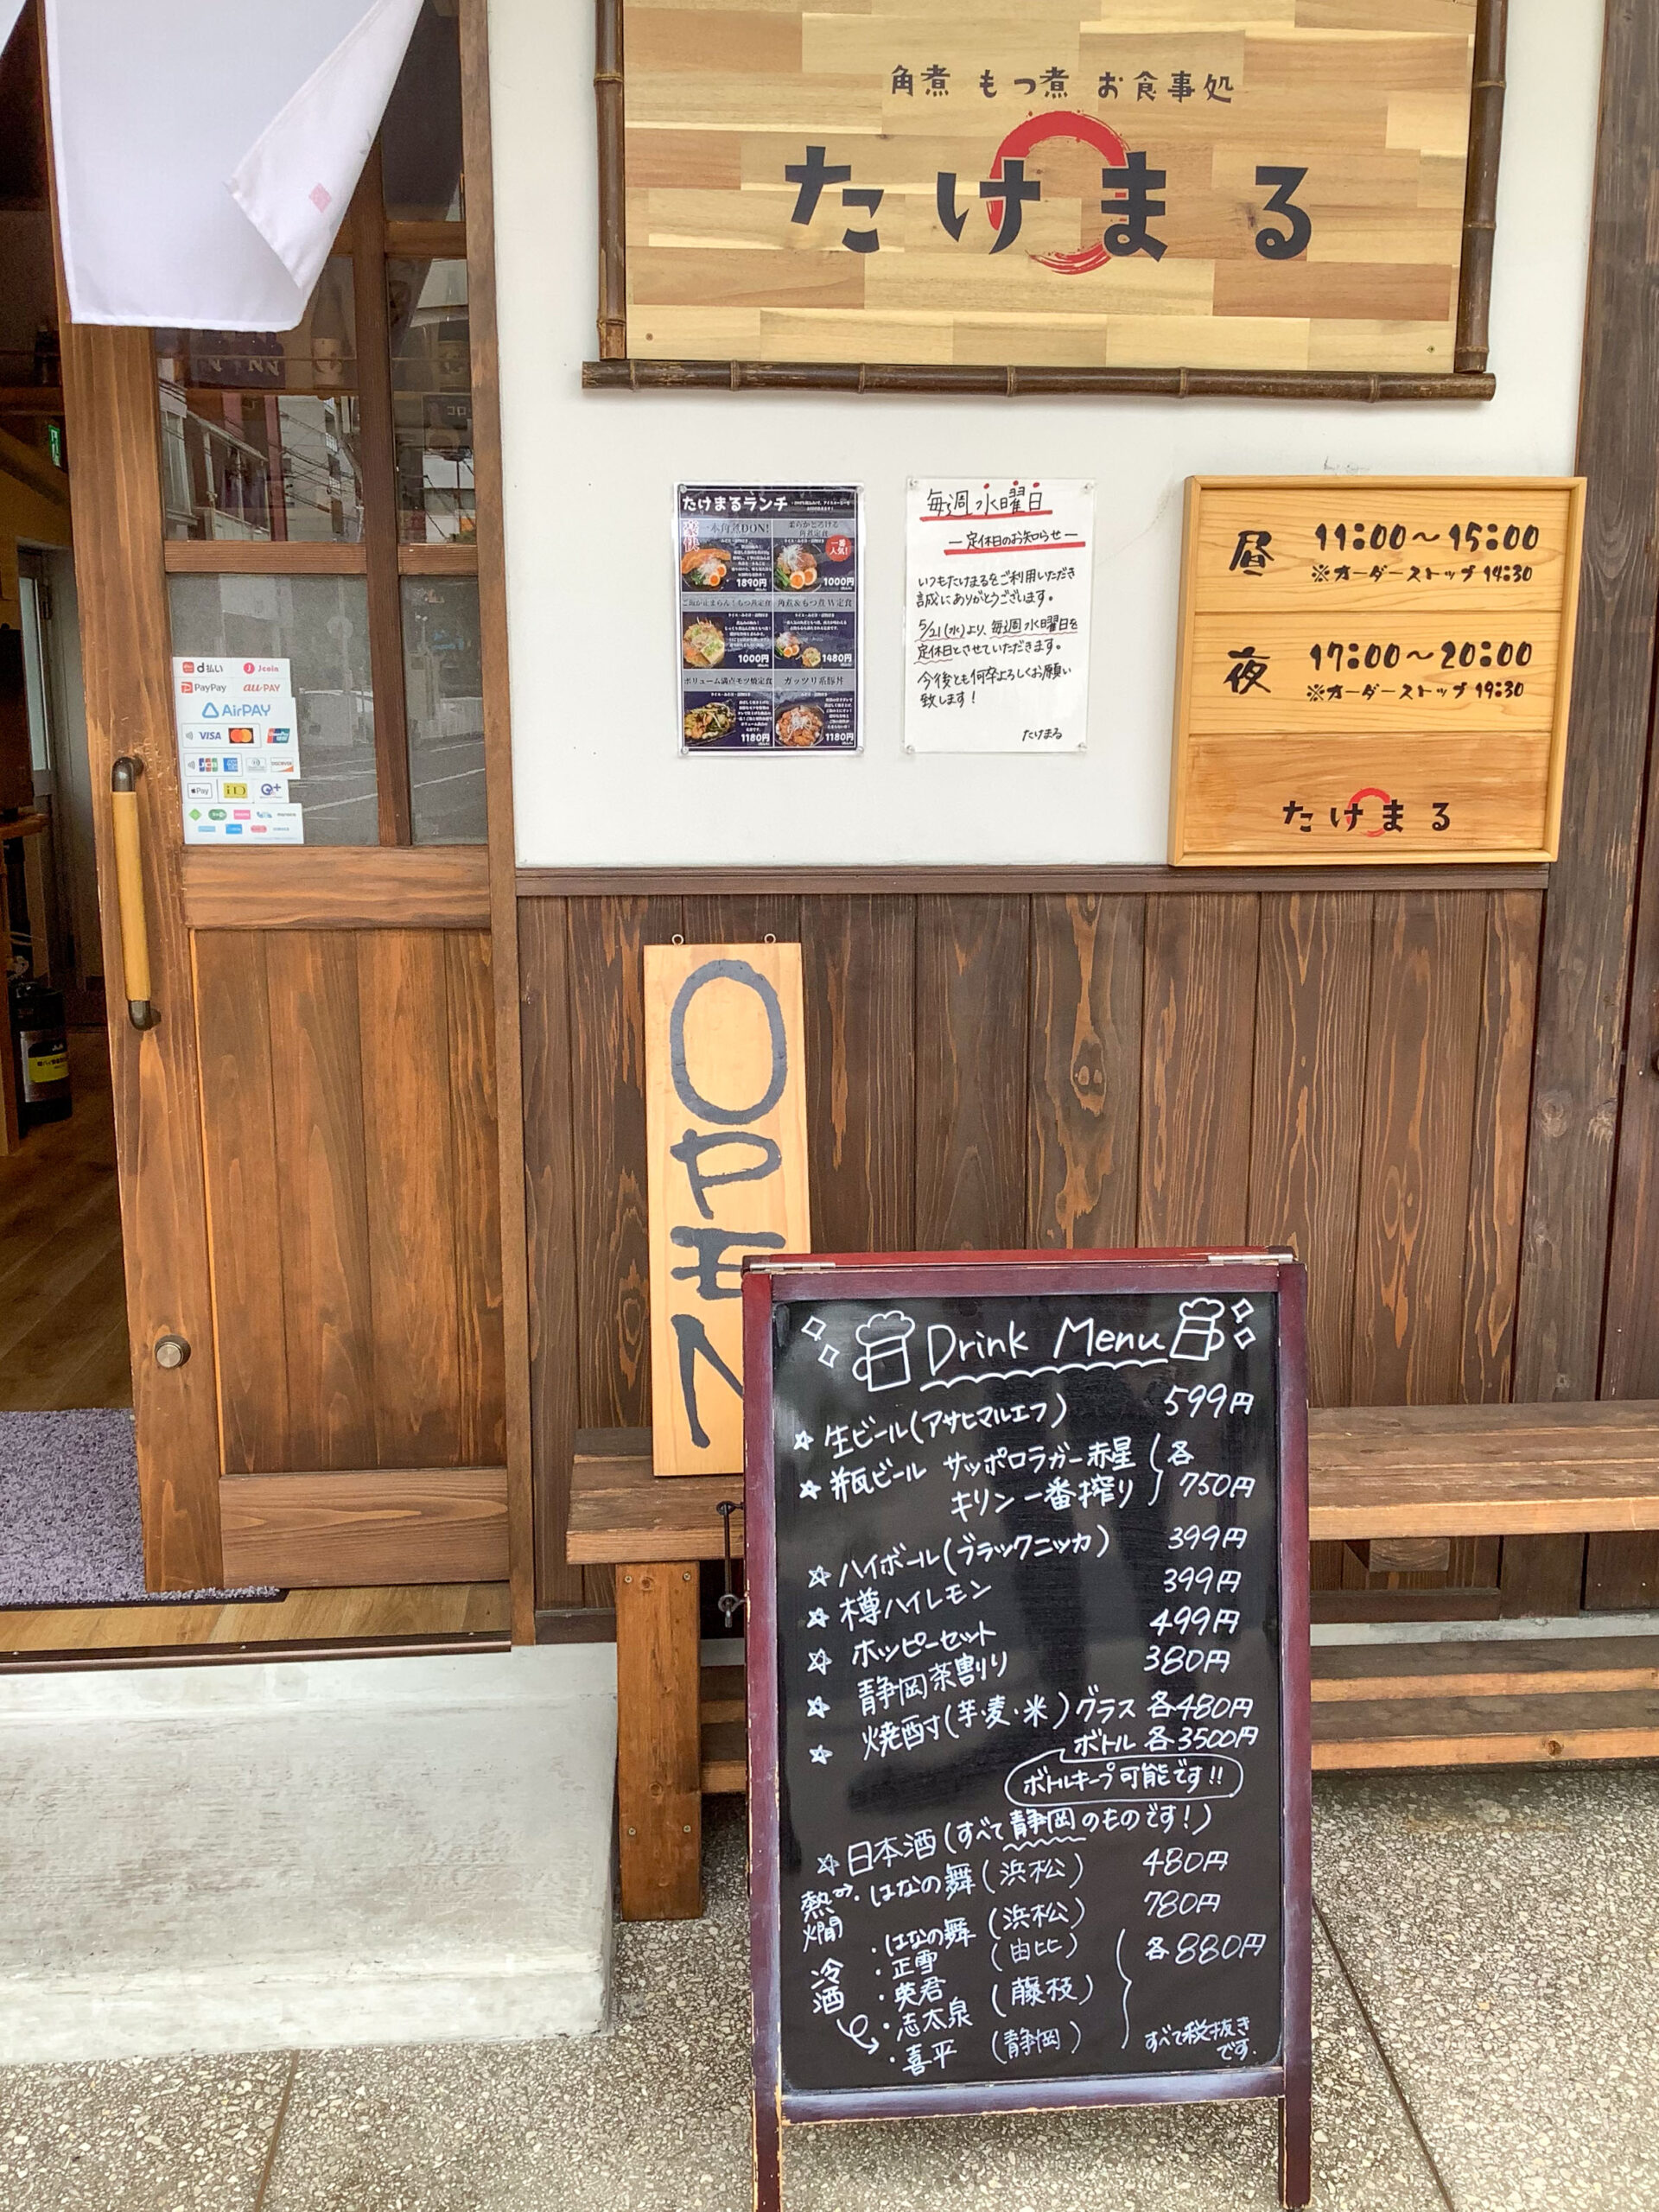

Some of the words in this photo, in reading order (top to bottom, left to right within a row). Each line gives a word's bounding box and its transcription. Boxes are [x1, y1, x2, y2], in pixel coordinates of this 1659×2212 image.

[890, 64, 952, 98] 角煮
[978, 67, 1070, 100] もつ煮
[1097, 70, 1236, 104] お食事処
[784, 145, 1313, 264] たけまる
[682, 496, 788, 512] たけまるランチ
[927, 486, 1043, 517] 毎週水曜日
[1229, 530, 1274, 577] 昼
[736, 578, 767, 588] 1890円
[823, 576, 855, 587] 1000円
[918, 567, 1076, 589] いつもたけまるをご利用いただき
[738, 654, 769, 664] 1000円
[822, 653, 853, 664] 1480円
[1224, 645, 1272, 695] 夜
[194, 683, 226, 694] PayPay
[917, 662, 1072, 690] 今後とも何卒よろしくお願い
[221, 703, 271, 717] AirPAY
[199, 731, 222, 741] VISA
[741, 734, 770, 743] 1180円
[825, 732, 855, 742] 1180円
[1022, 728, 1063, 742] たけまる
[1283, 798, 1451, 834] たけまる
[927, 1319, 1028, 1376] Drink
[1053, 1316, 1166, 1358] Menu
[1164, 1383, 1254, 1418] 599円
[830, 1458, 927, 1503] 瓶ビール
[944, 1436, 1136, 1482] サッポロラガー赤星
[1167, 1440, 1195, 1466] 各
[1179, 1471, 1256, 1499] 750円
[1167, 1525, 1249, 1551] 399円
[1163, 1567, 1242, 1595] 399円
[851, 1619, 998, 1668] ホッピーセット
[1149, 1606, 1241, 1637] 499円
[857, 1650, 1009, 1716] 静岡茶割り
[1143, 1645, 1231, 1675] 380円
[1073, 1726, 1136, 1758] ボトル
[1142, 1849, 1229, 1878] 480円
[1143, 1890, 1221, 1919] 780円
[810, 1957, 844, 2016] 冷酒
[1144, 2016, 1250, 2054] すべて税抜き
